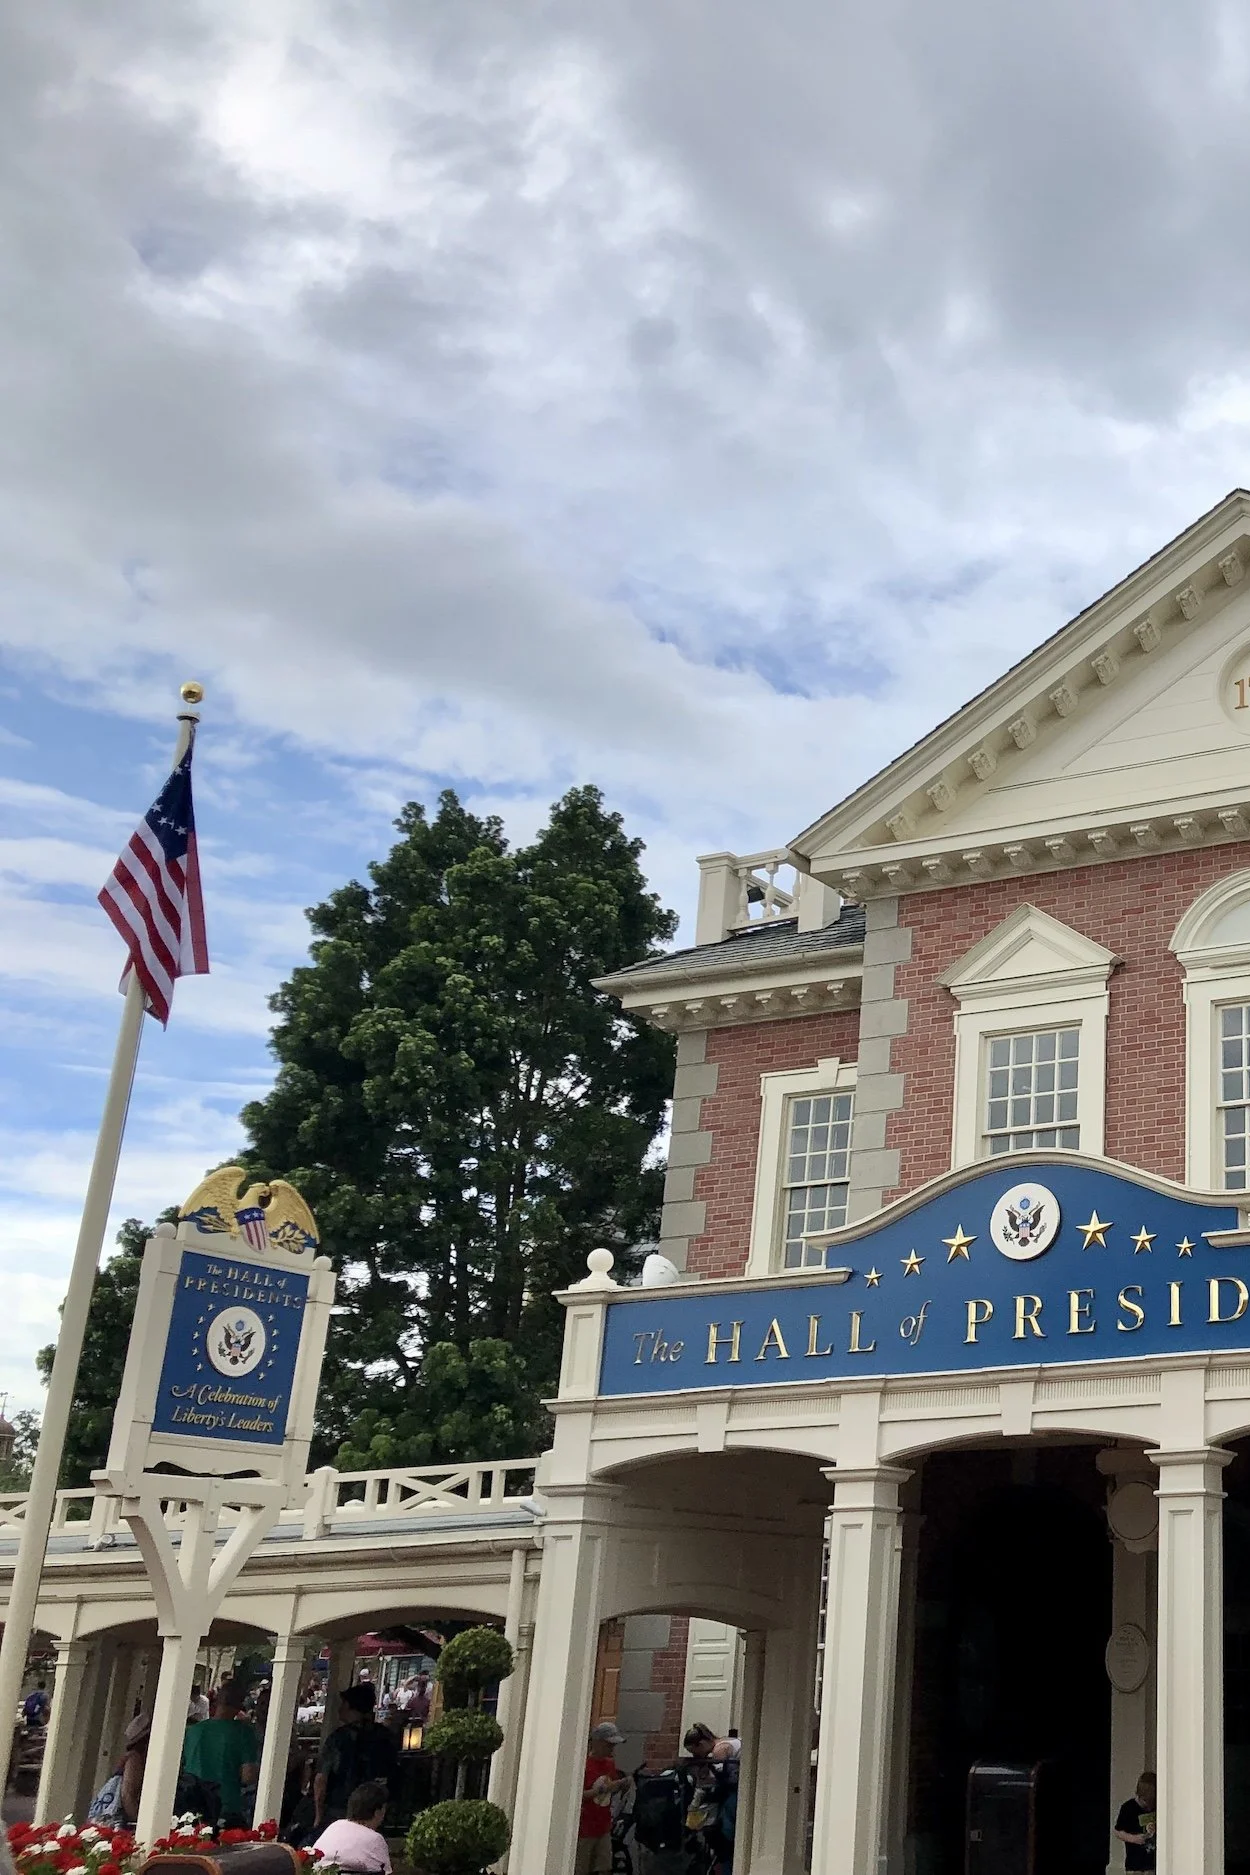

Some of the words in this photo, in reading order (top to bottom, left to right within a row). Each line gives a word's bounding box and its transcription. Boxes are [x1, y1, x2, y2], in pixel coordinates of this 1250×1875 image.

[184, 1276, 302, 1309] PRESIDENTS
[206, 1264, 223, 1276] The
[227, 1267, 274, 1287] HALL
[277, 1278, 288, 1290] of
[632, 1328, 686, 1366] The
[703, 1309, 877, 1365] HALL
[899, 1299, 932, 1346] of
[171, 1383, 198, 1399] A
[197, 1384, 267, 1408] Celebration
[267, 1394, 283, 1414] of
[171, 1405, 227, 1431] Liberty's
[227, 1412, 275, 1433] Leaders
